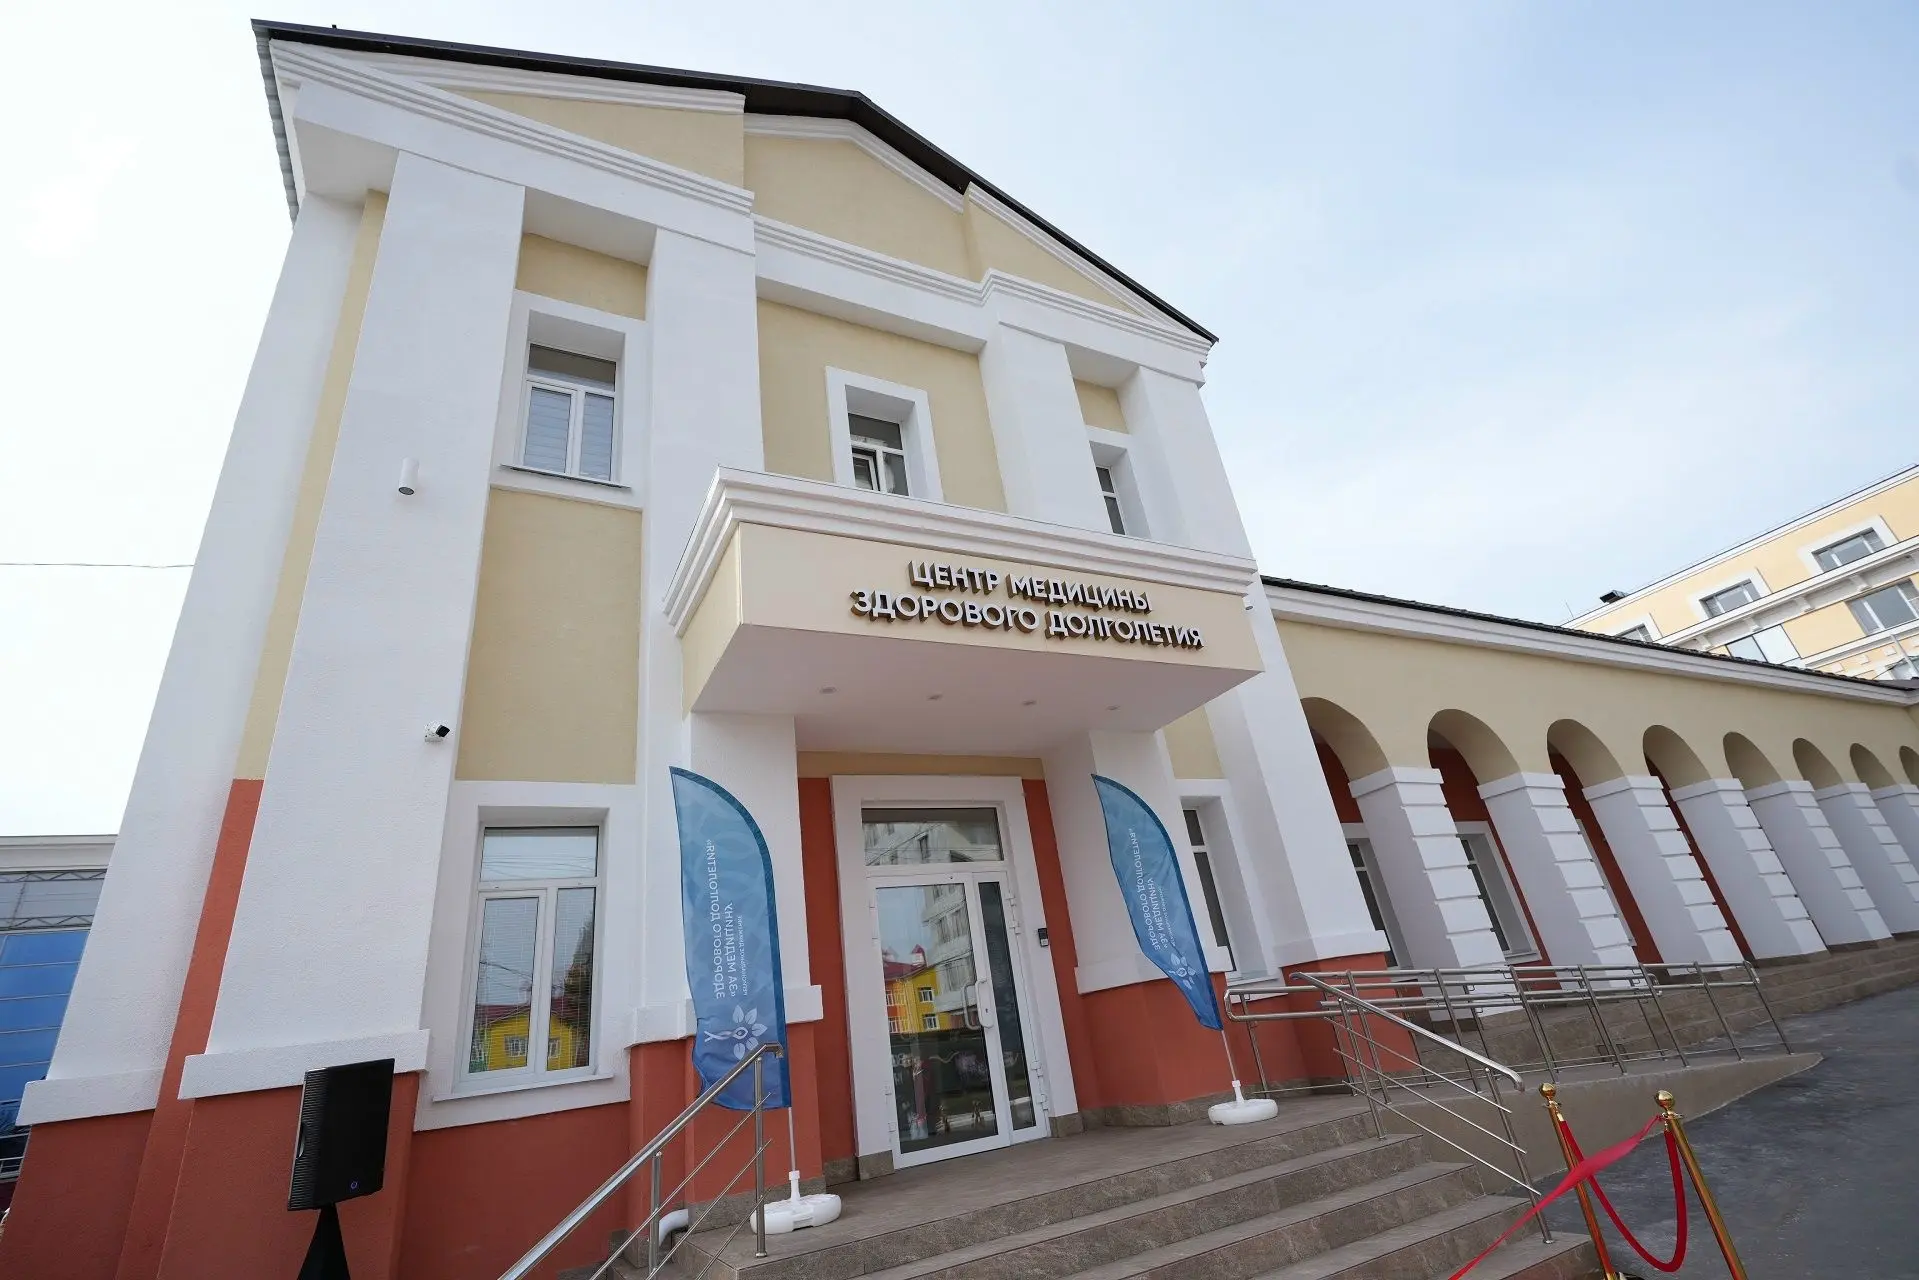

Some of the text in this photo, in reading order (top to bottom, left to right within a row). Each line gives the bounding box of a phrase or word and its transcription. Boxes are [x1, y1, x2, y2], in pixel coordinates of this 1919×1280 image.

[909, 560, 1153, 615] ЦЕНТР МЕДИЦИНЫ
[850, 589, 1205, 650] ЗДОРОВОГО ДОЛГОЛЕТИЯ
